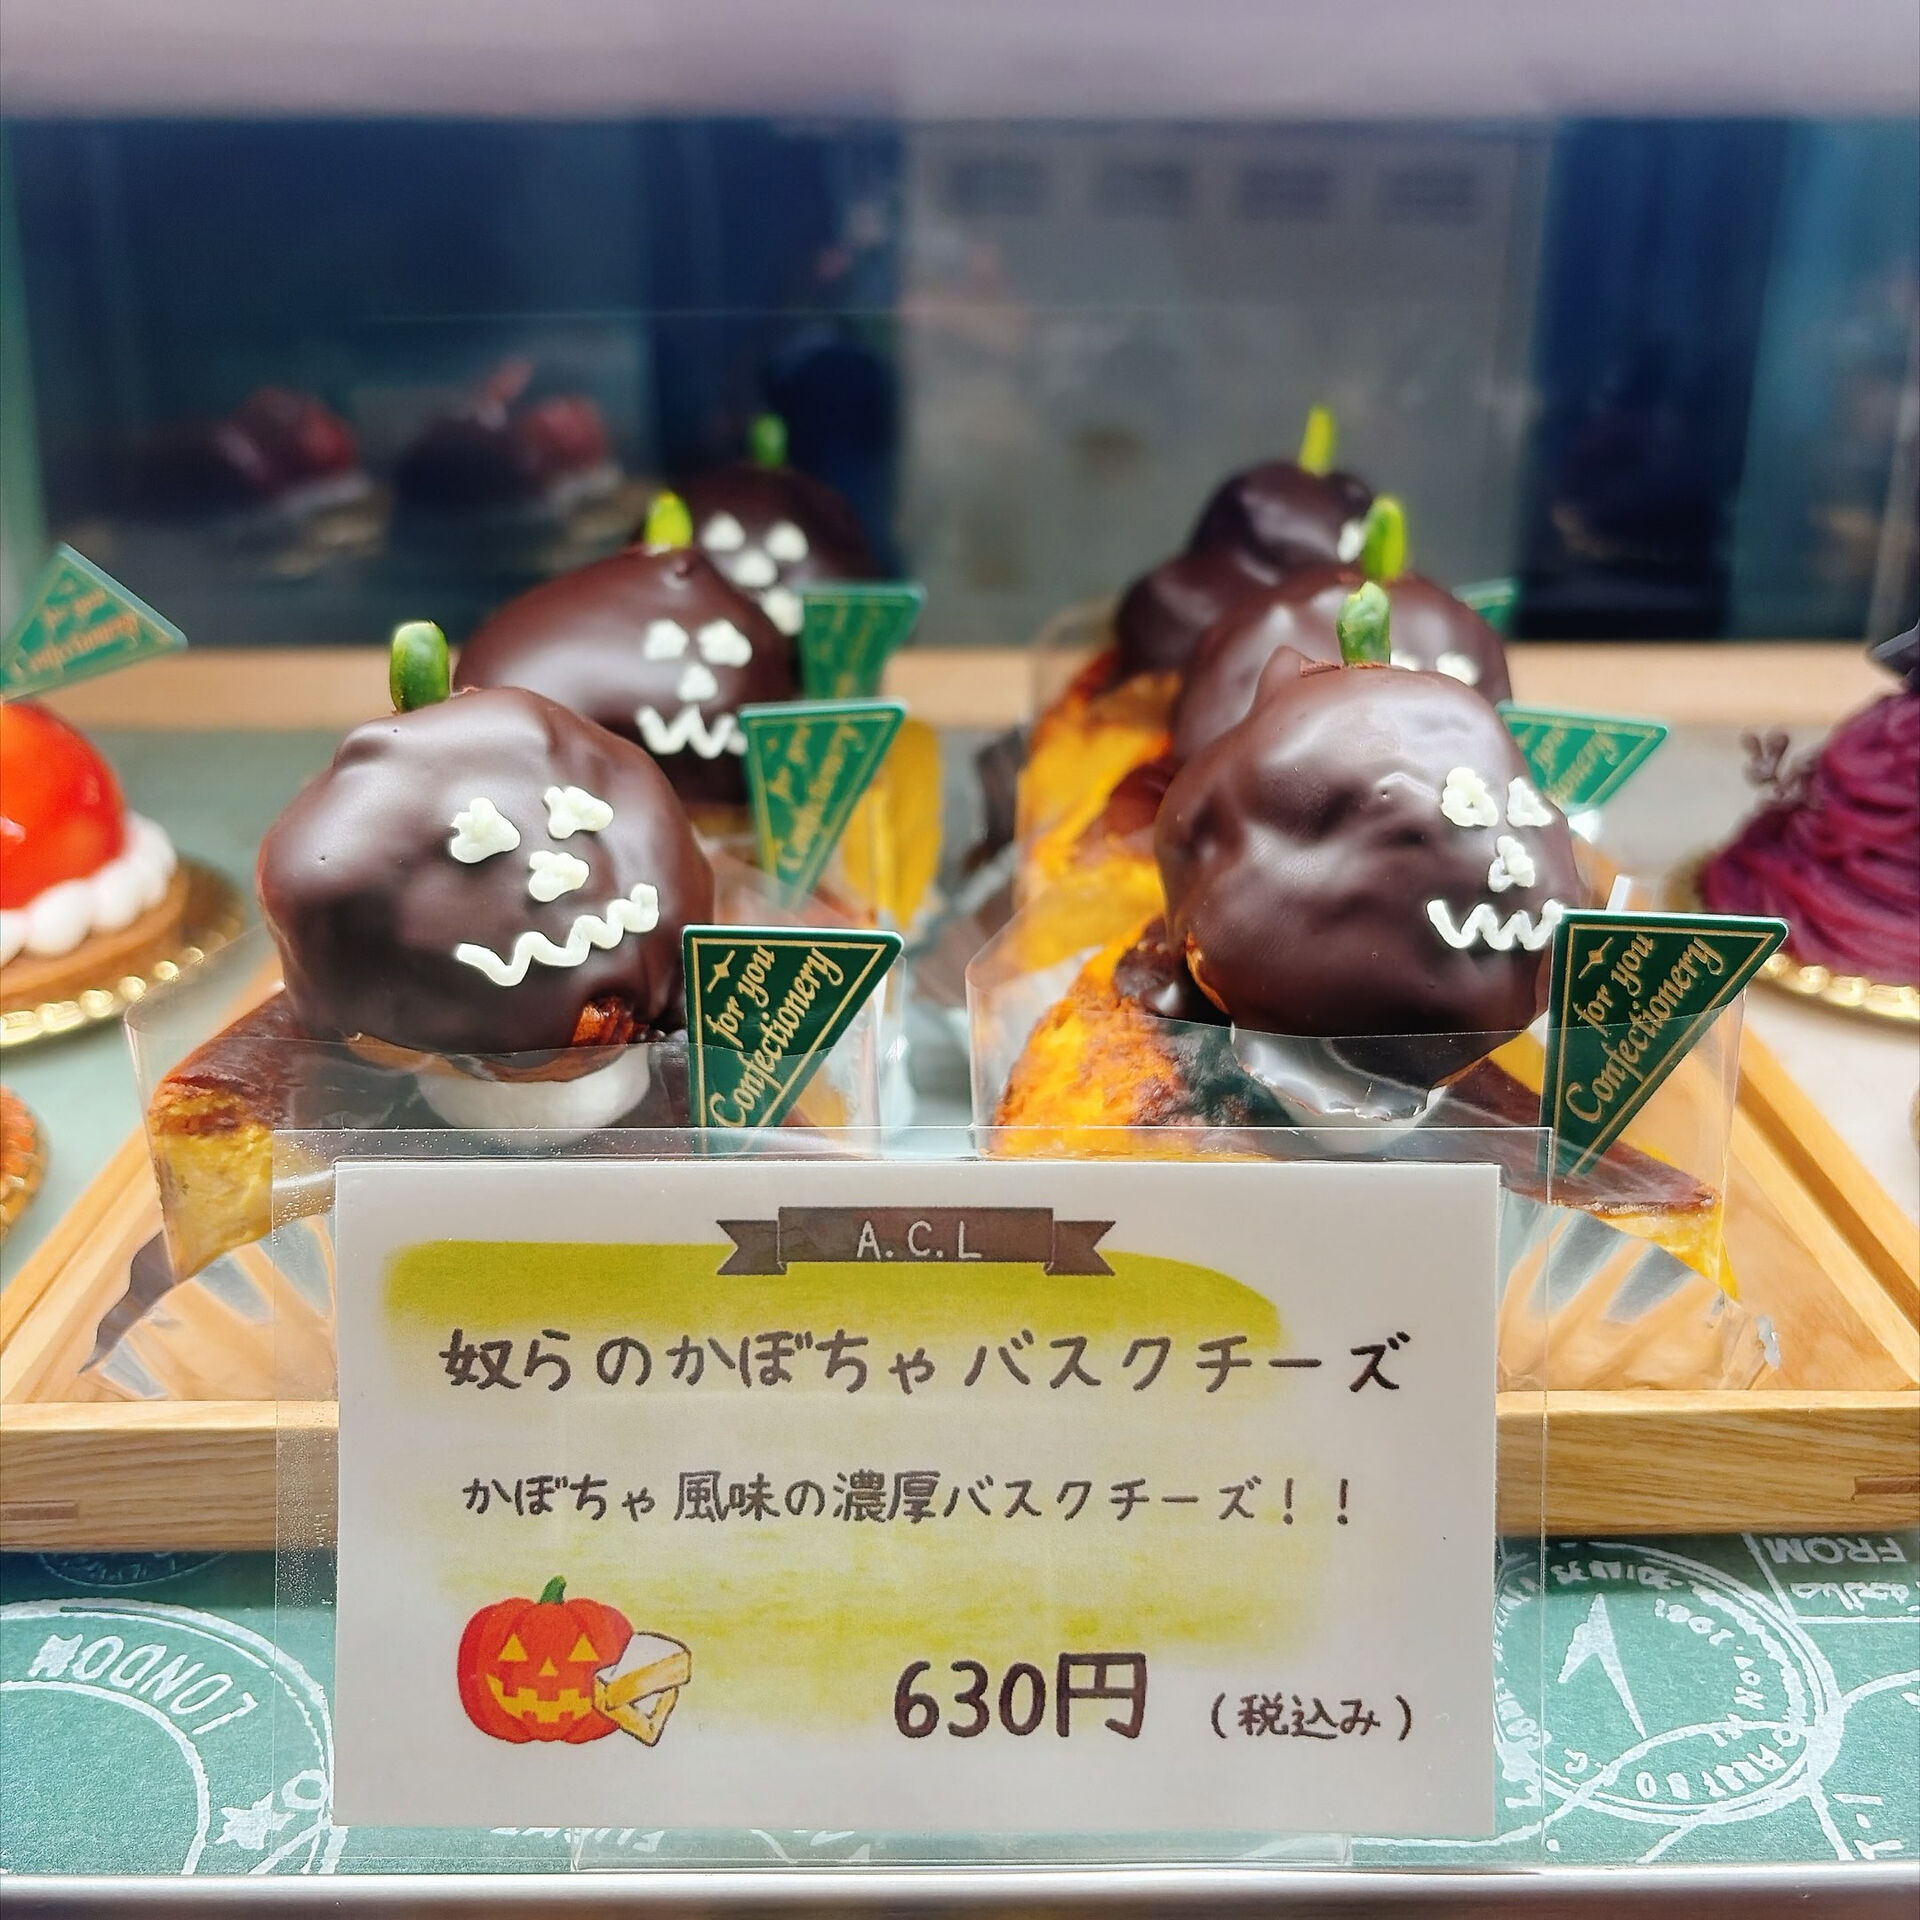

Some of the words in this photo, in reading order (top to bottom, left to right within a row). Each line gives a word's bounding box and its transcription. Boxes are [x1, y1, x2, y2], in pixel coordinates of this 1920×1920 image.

[705, 995, 745, 1049] for
[737, 945, 776, 1008] you
[1565, 936, 1725, 1125] Confectionery
[1572, 984, 1614, 1038] for
[1611, 932, 1655, 997] you
[709, 946, 845, 1127] Confectionery
[855, 1219, 983, 1262] A.C.L
[438, 1327, 1411, 1395] 奴らのかぼちゃバスクチーズ
[1763, 1536, 1907, 1564] FROM
[894, 1651, 1148, 1739] 630円
